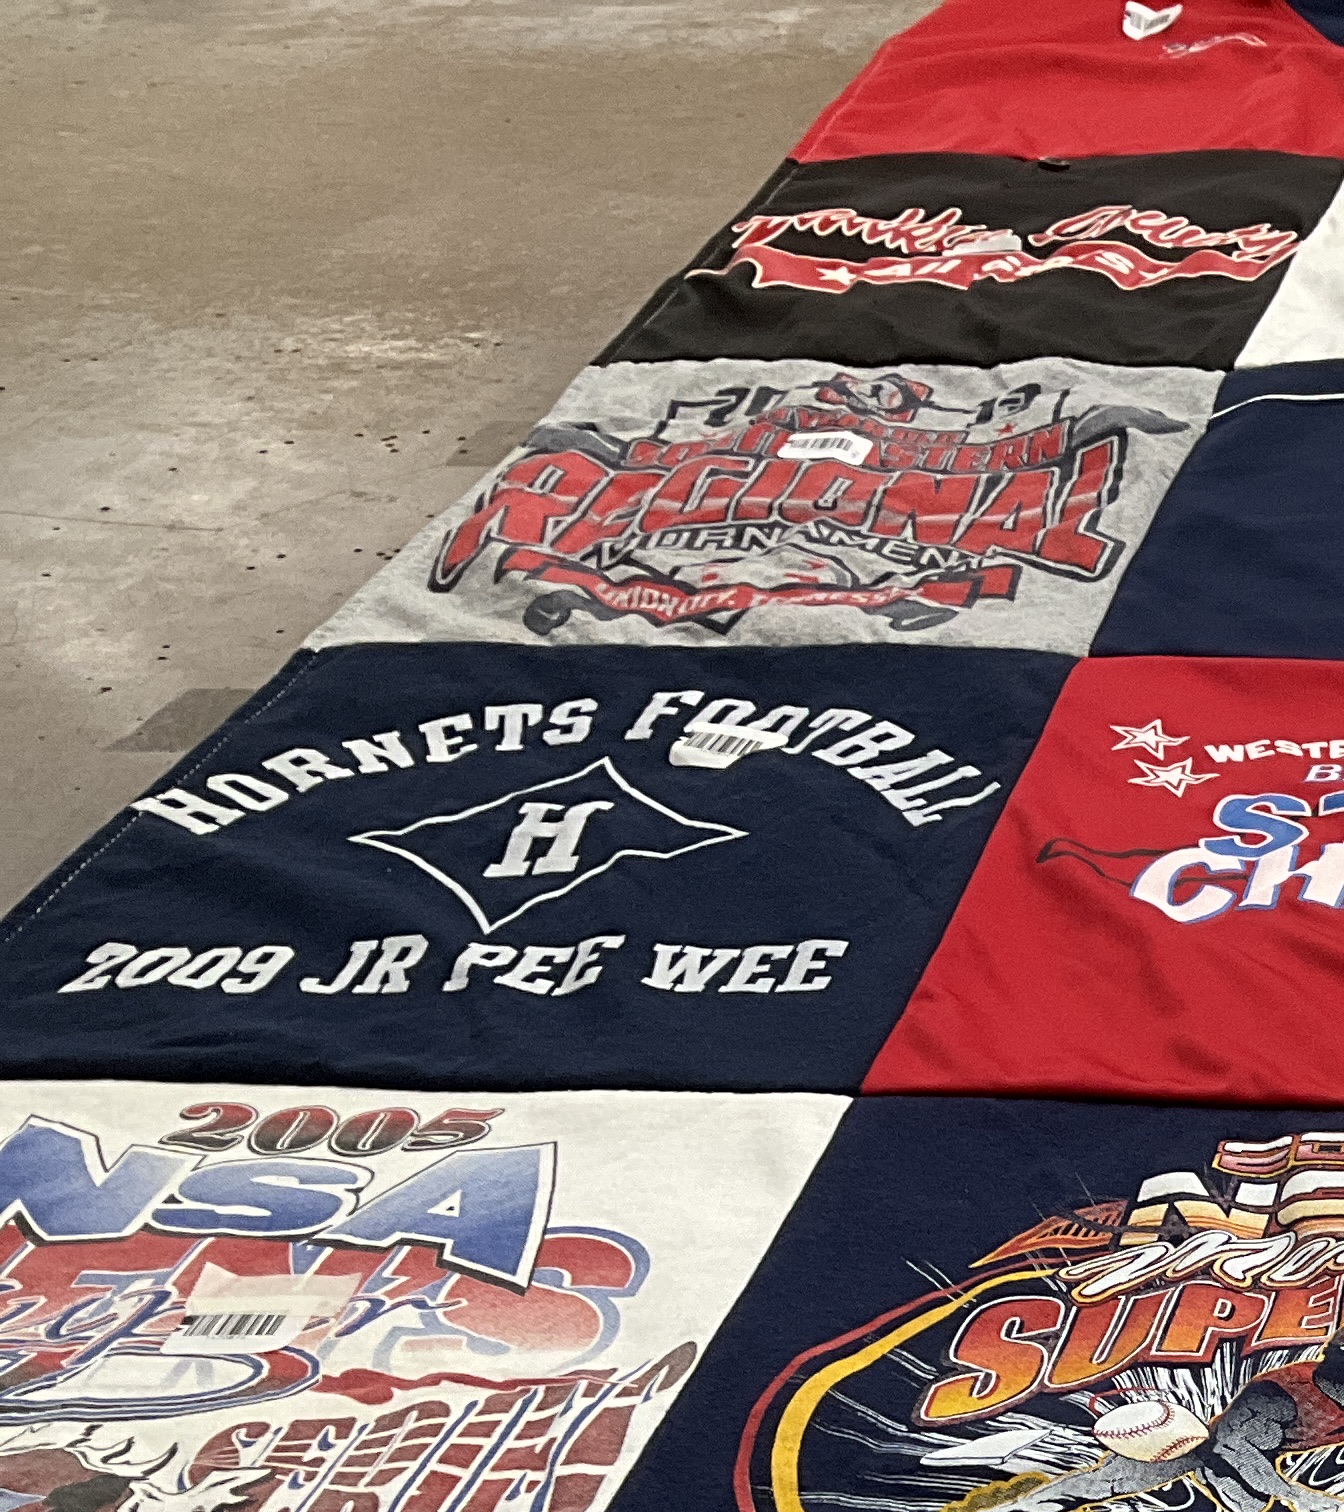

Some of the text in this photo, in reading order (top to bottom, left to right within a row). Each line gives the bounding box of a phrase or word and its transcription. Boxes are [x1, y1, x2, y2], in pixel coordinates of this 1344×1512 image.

[428, 427, 1130, 592] REGIONAL
[131, 688, 1002, 836] HORNETS FOOTBALL
[483, 801, 614, 878] H
[59, 934, 849, 997] 2009 JR PEE WEE
[157, 1101, 505, 1157] 2005
[0, 1114, 559, 1297] NSA
